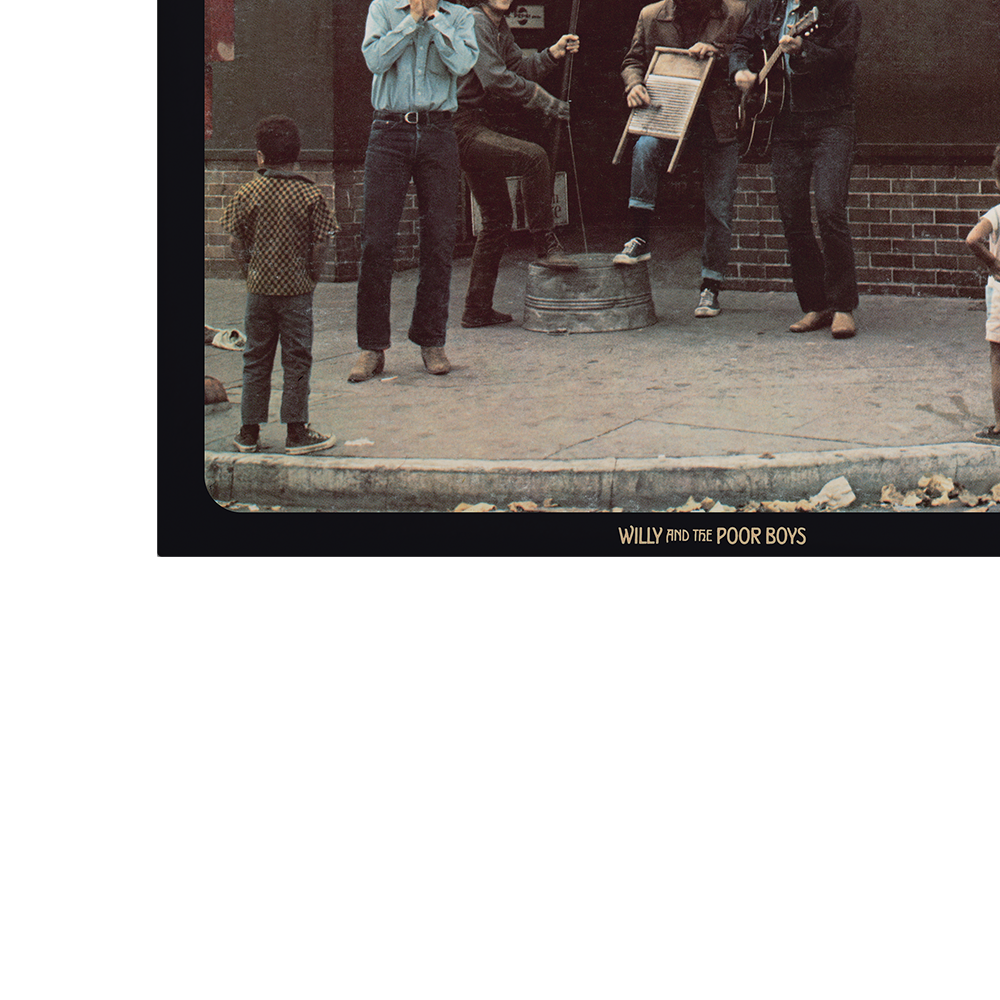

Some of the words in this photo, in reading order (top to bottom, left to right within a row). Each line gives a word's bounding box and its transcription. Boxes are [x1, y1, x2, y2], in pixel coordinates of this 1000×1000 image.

[618, 525, 663, 545] WILLY
[666, 528, 690, 543] AND
[692, 528, 713, 542] THE
[716, 526, 761, 545] POOR
[765, 526, 807, 545] BOYS
